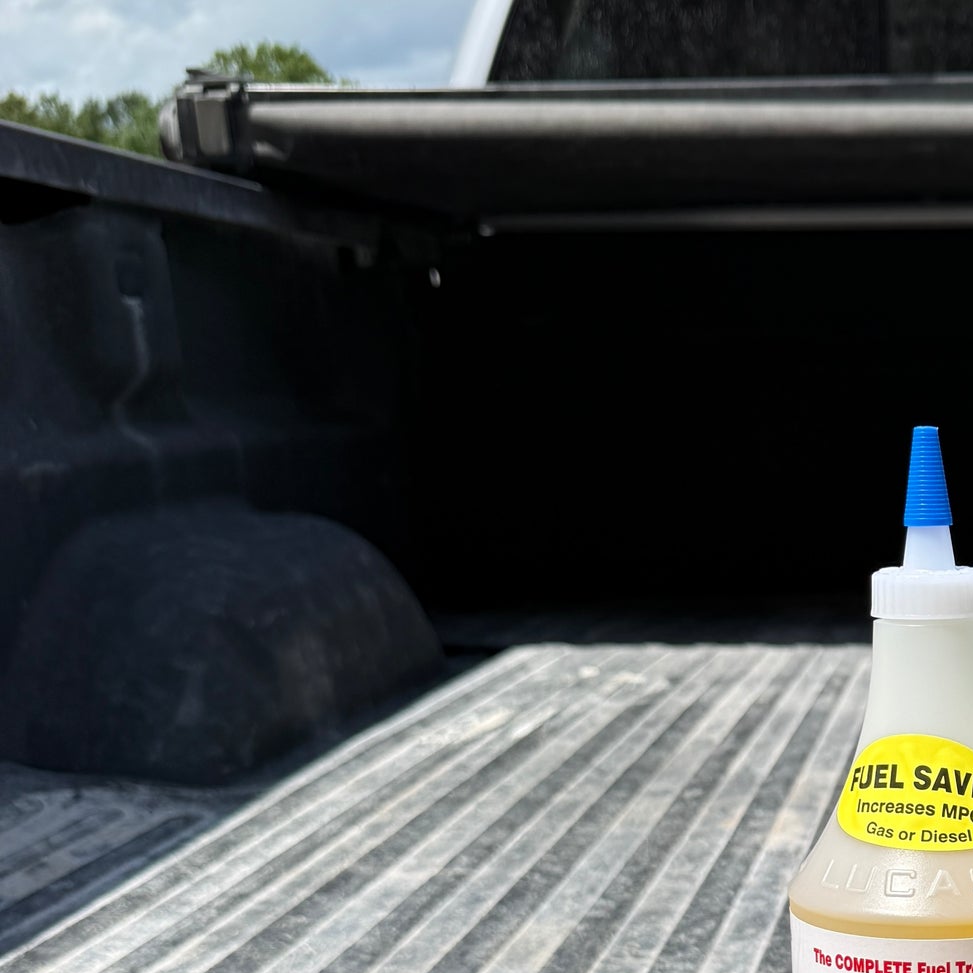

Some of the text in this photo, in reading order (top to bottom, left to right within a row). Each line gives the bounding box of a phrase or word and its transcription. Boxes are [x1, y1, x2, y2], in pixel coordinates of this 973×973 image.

[850, 764, 904, 792] FUEL
[856, 798, 936, 817] Increases
[866, 821, 973, 843] Gas or Diesel
[813, 948, 832, 968] The
